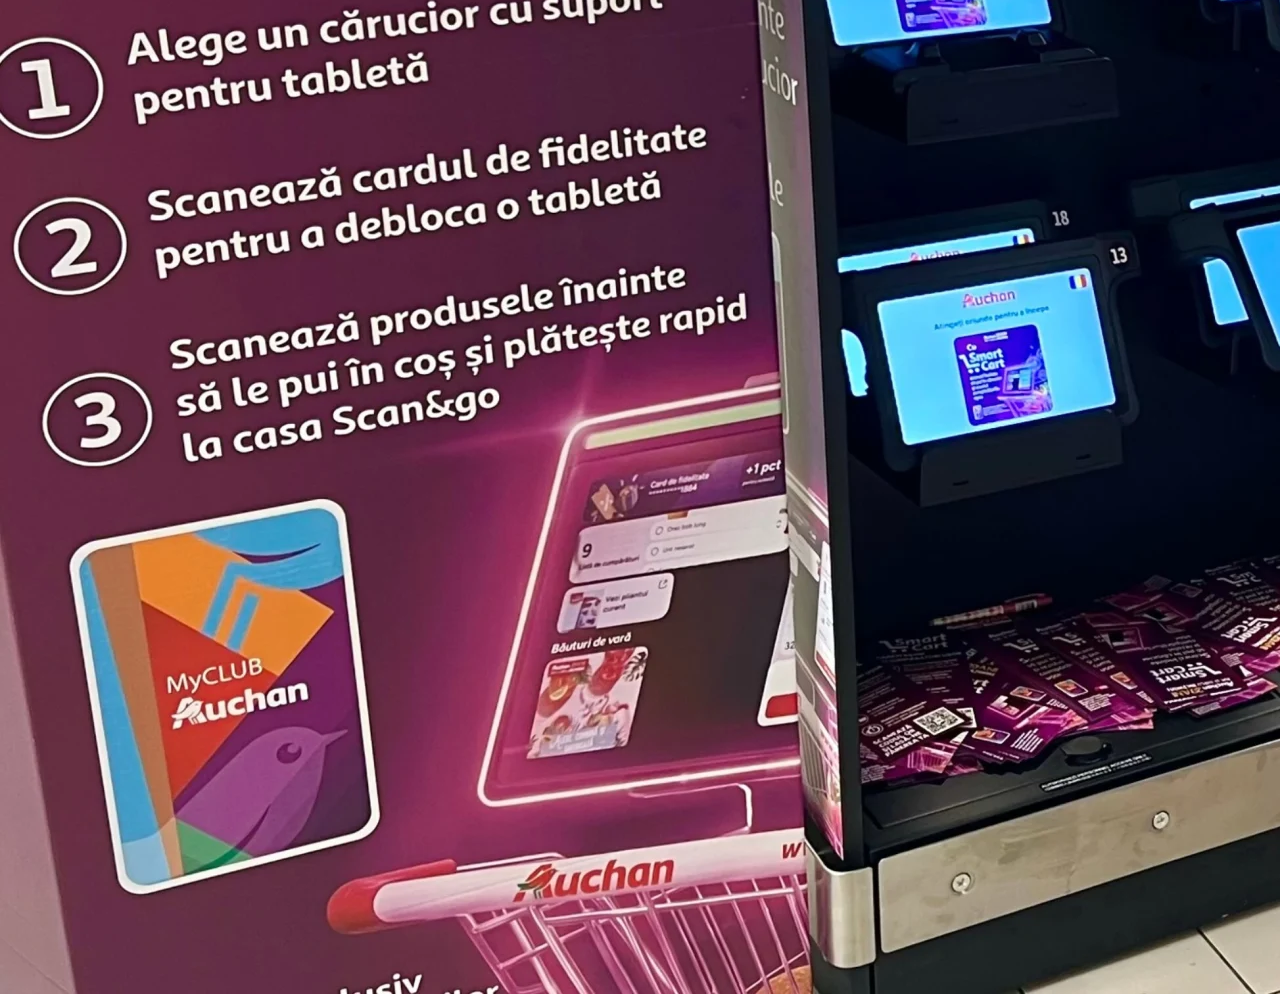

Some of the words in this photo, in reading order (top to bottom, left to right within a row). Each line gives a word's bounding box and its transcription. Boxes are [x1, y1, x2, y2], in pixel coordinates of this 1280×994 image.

[21, 58, 70, 120] 1
[127, 29, 248, 66] Alege
[257, 23, 309, 51] un
[319, 0, 480, 44] cărucior
[489, 0, 533, 26] cu
[134, 77, 272, 125] pentru
[281, 52, 430, 99] tabletă
[45, 217, 97, 278] 2
[148, 166, 343, 222] Scanează
[353, 149, 477, 194] cardul
[486, 144, 531, 175] de
[538, 124, 708, 169] fidelitate
[1052, 210, 1070, 226] 18
[155, 230, 290, 280] pentru
[301, 225, 325, 249] a
[335, 202, 487, 244] debloca
[496, 198, 520, 221] o
[527, 170, 662, 216] tabletă
[1110, 247, 1128, 264] 13
[962, 289, 1016, 308] Auchan
[74, 391, 122, 449] 3
[169, 311, 360, 370] Scanează
[370, 283, 554, 346] produsele
[558, 265, 687, 307] înainte
[176, 381, 222, 417] să
[232, 376, 269, 407] le
[279, 361, 339, 408] pui
[344, 358, 385, 388] în
[394, 349, 456, 380] coș
[466, 334, 495, 376] și
[503, 314, 651, 369] plătește
[659, 293, 747, 336] rapid
[969, 348, 1004, 363] Smart
[981, 358, 1005, 372] Cart
[182, 432, 223, 463] la
[233, 418, 322, 454] casa
[332, 386, 500, 436] Scan&go
[650, 479, 668, 489] Card
[582, 543, 592, 558] 9
[551, 638, 592, 656] Băuturi
[593, 636, 606, 648] de
[166, 658, 263, 694] MyCLUB
[171, 682, 309, 730] Auchan
[514, 858, 674, 903] Auchan
